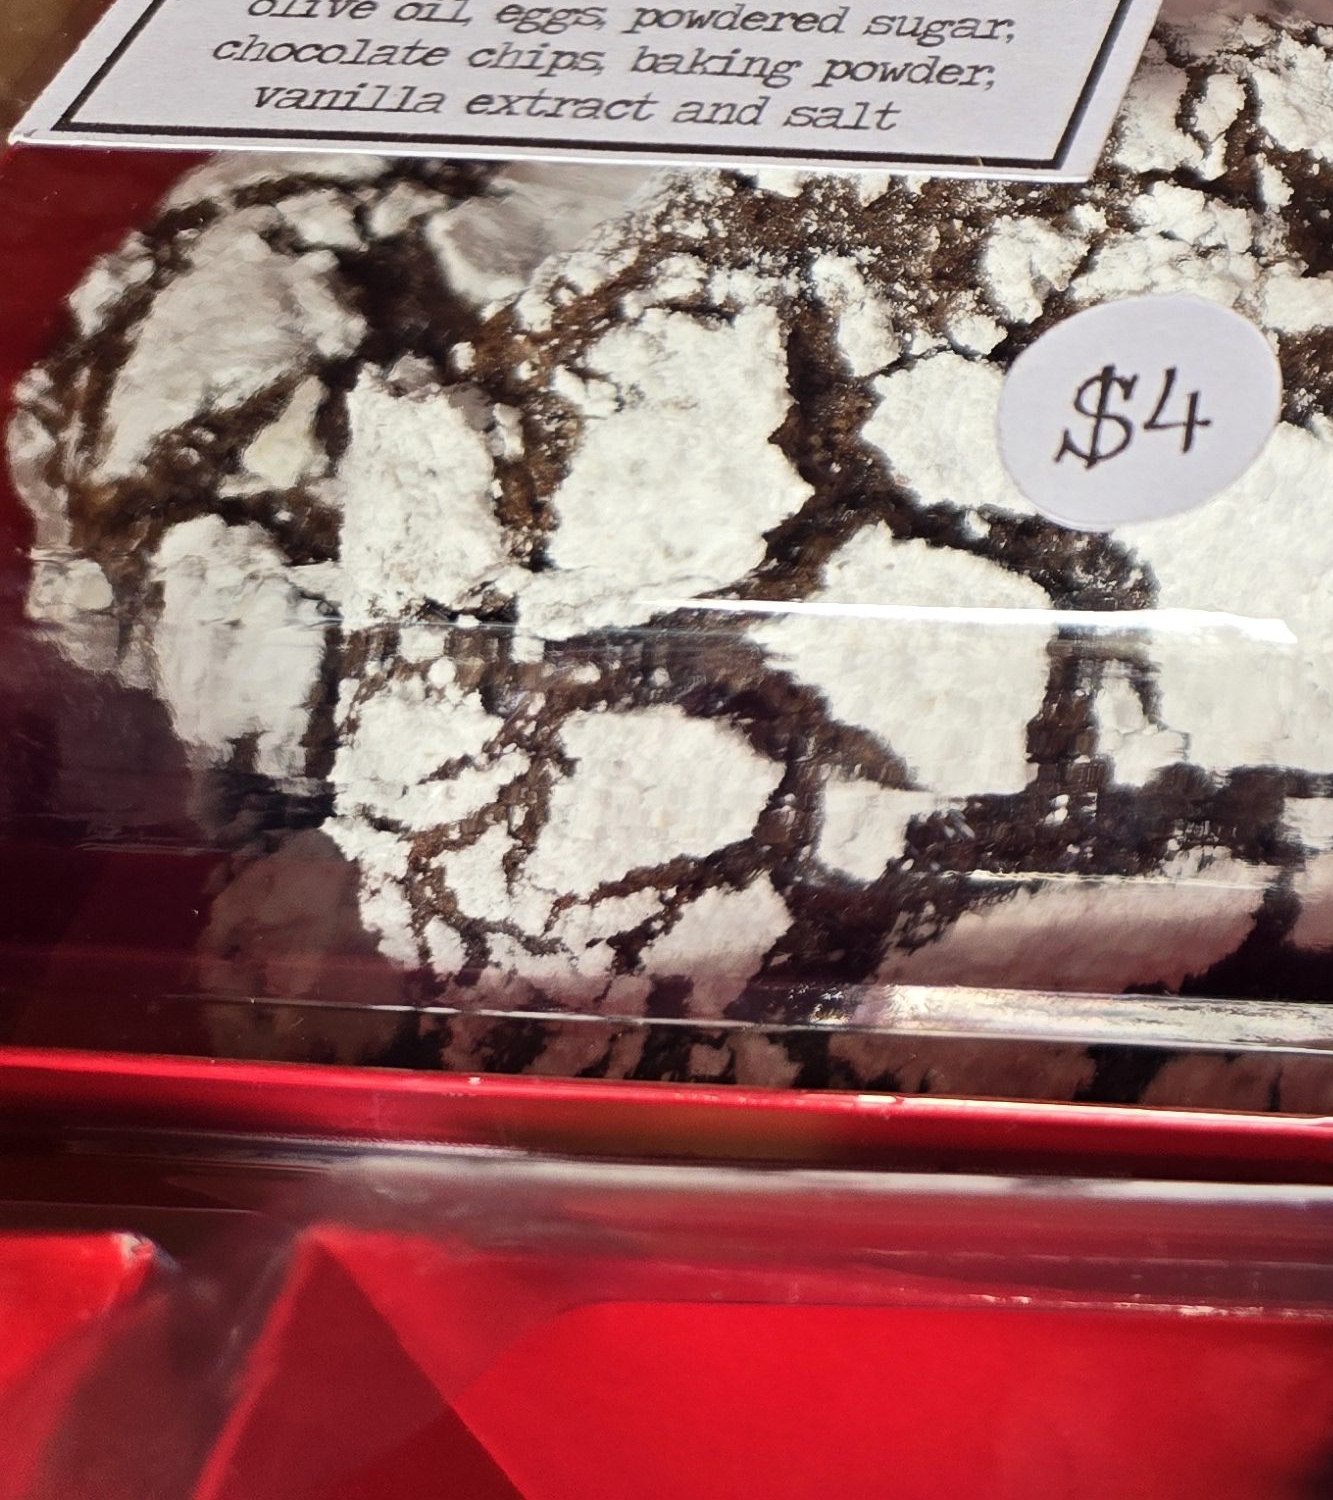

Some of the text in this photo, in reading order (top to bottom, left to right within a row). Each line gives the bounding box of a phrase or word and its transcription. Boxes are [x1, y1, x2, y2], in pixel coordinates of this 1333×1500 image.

[495, 2, 607, 34] eggs,
[621, 3, 850, 35] powdered
[861, 14, 1015, 48] sugar,
[211, 34, 998, 91] chocolate chips, baking powder,
[253, 82, 903, 132] vanilla extract and salt
[1053, 363, 1212, 470] $4
